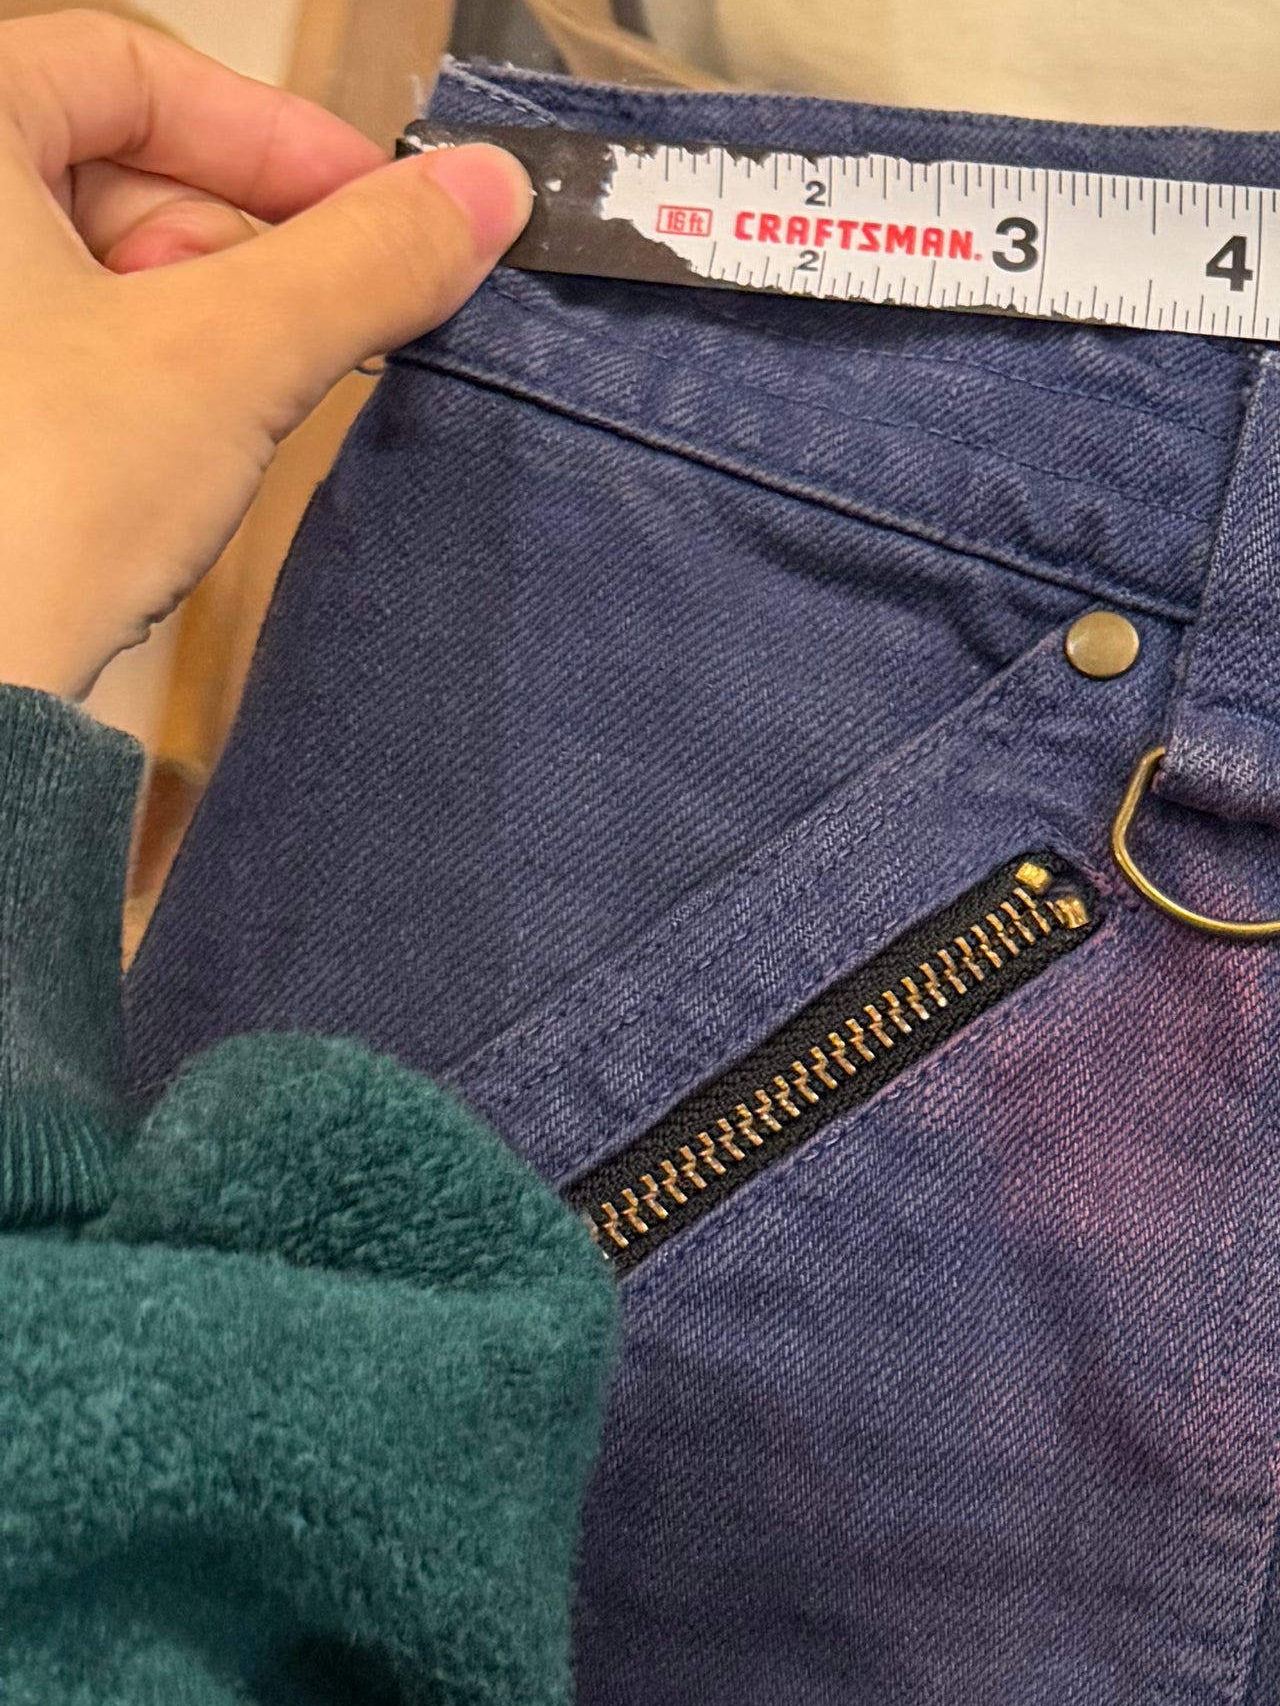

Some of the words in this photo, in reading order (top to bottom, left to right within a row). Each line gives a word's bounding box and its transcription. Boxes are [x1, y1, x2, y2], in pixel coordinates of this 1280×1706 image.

[804, 180, 827, 207] 2
[689, 212, 705, 234] ft
[733, 210, 974, 261] CRAFTSMAN
[798, 249, 820, 272] 2
[991, 216, 1039, 273] 3
[1205, 234, 1254, 292] 4
